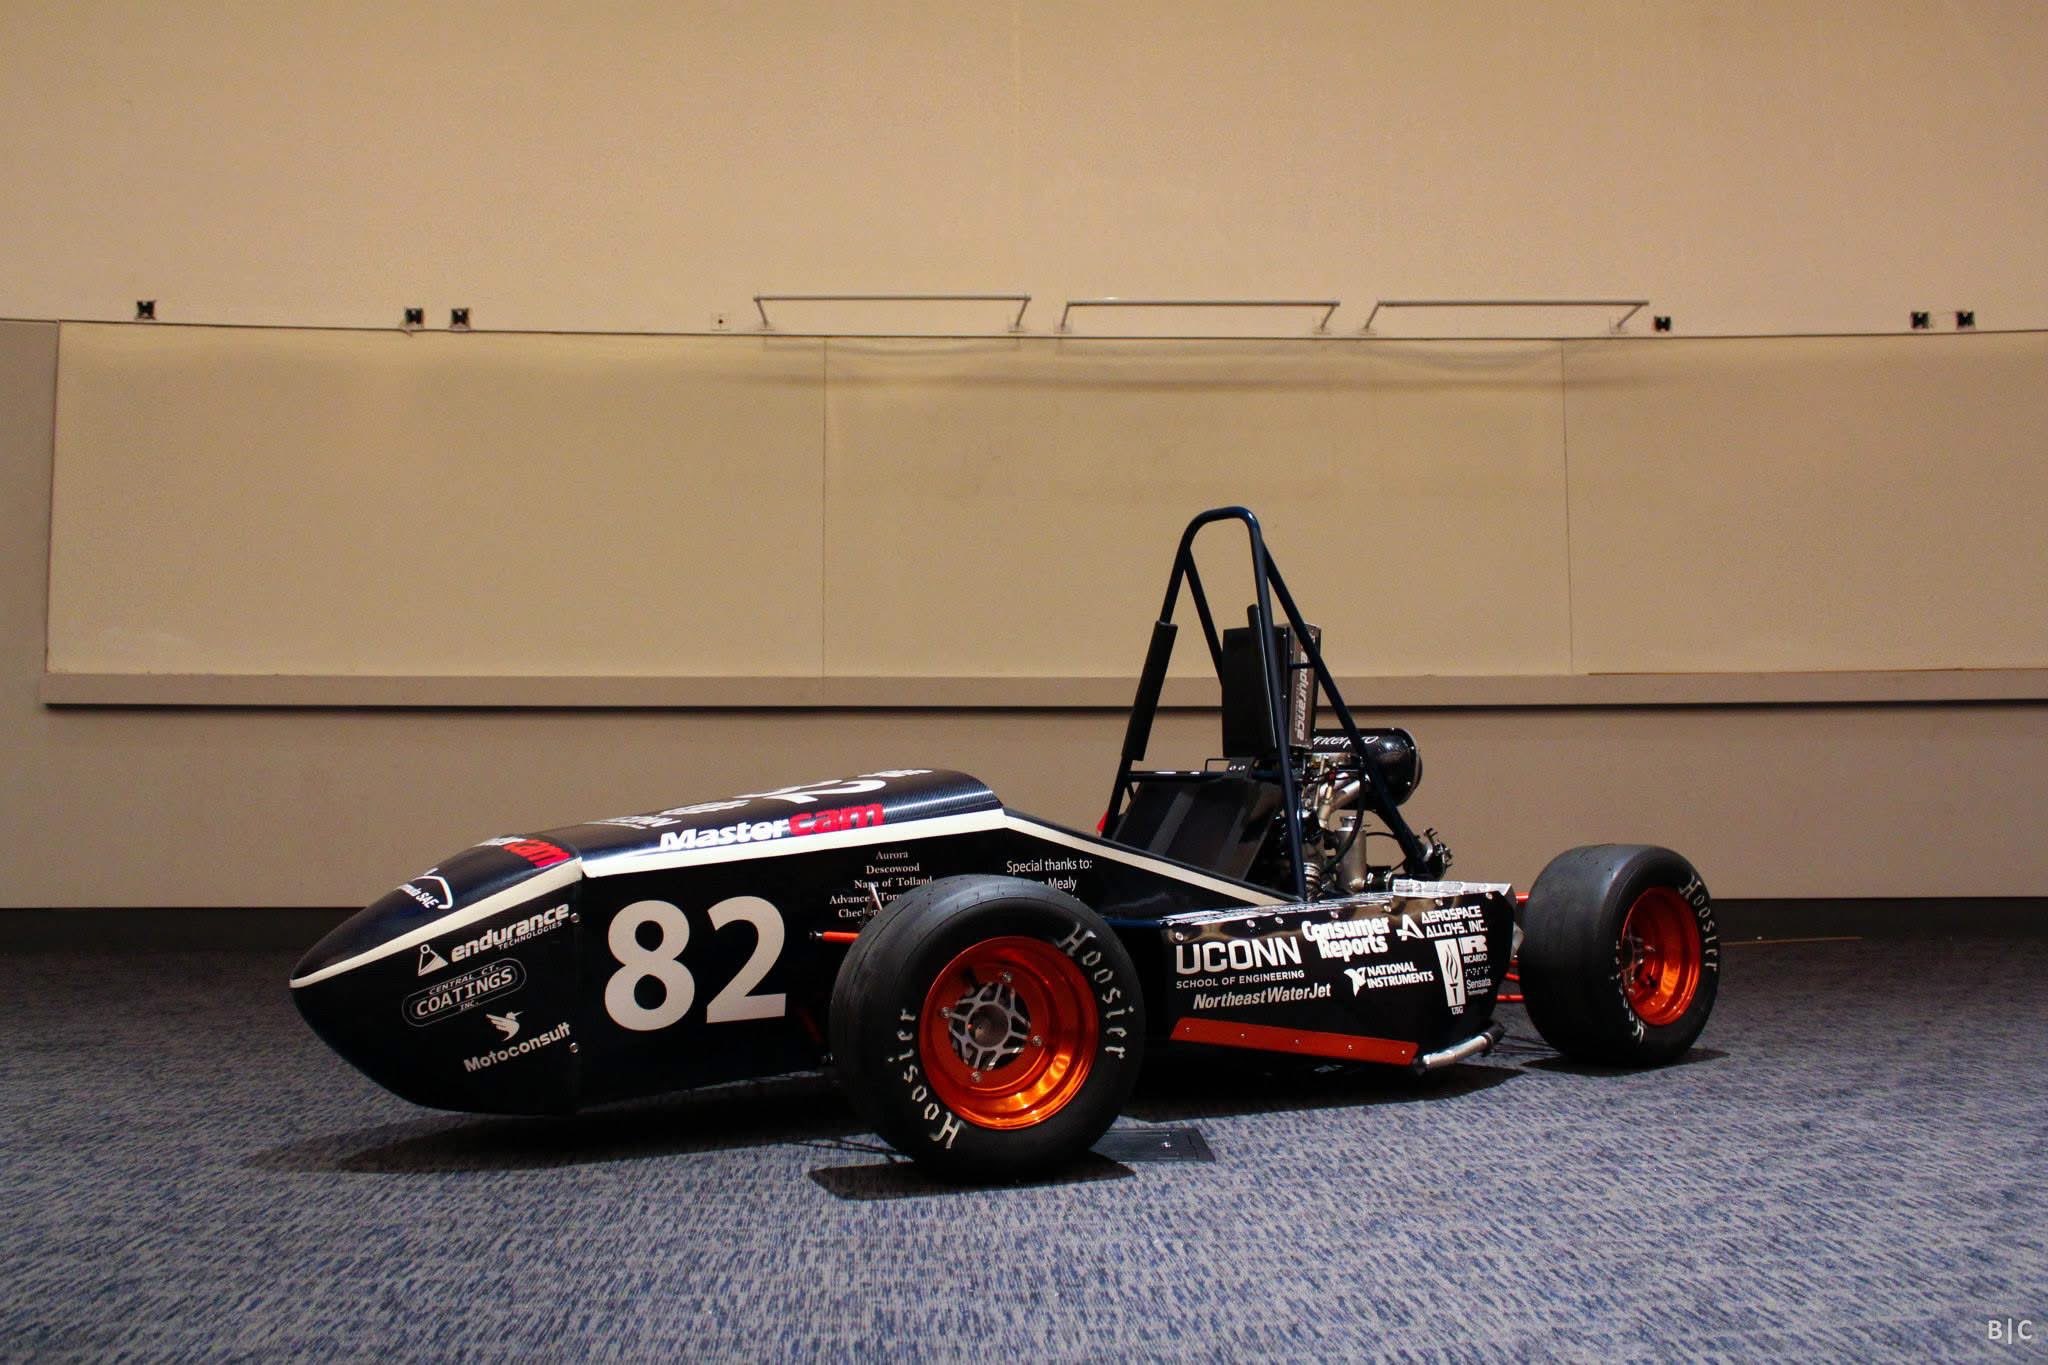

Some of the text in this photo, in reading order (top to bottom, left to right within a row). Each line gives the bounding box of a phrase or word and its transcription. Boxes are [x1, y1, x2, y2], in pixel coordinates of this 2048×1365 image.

[659, 803, 885, 850] Mastercam
[876, 851, 908, 860] Aurora
[866, 863, 920, 875] Descowood
[1006, 857, 1093, 876] Special thanks to:
[882, 877, 893, 887] of
[896, 875, 933, 887] Tolland
[1047, 876, 1077, 892] Mealy
[829, 895, 870, 905] Advance
[1421, 905, 1483, 924] AEROSPACE
[452, 903, 570, 963] endurance
[498, 920, 563, 950] TECHNOLOGIES
[1301, 917, 1390, 941] Consumer
[1468, 920, 1488, 933] INC.
[1176, 936, 1302, 974] UCONN
[1316, 934, 1388, 962] Reports
[604, 895, 787, 1032] 82
[1366, 961, 1417, 977] NATIONAL
[428, 974, 473, 995] CENTRAL
[1176, 970, 1305, 989] SCHOOL OF ENGINEERING
[1366, 971, 1434, 988] INSTRUMENTS
[416, 967, 513, 1016] COATINGS
[1056, 922, 1134, 1060] Hoosier
[463, 1021, 571, 1072] Motoconsult
[887, 1007, 965, 1149] Hoosier
